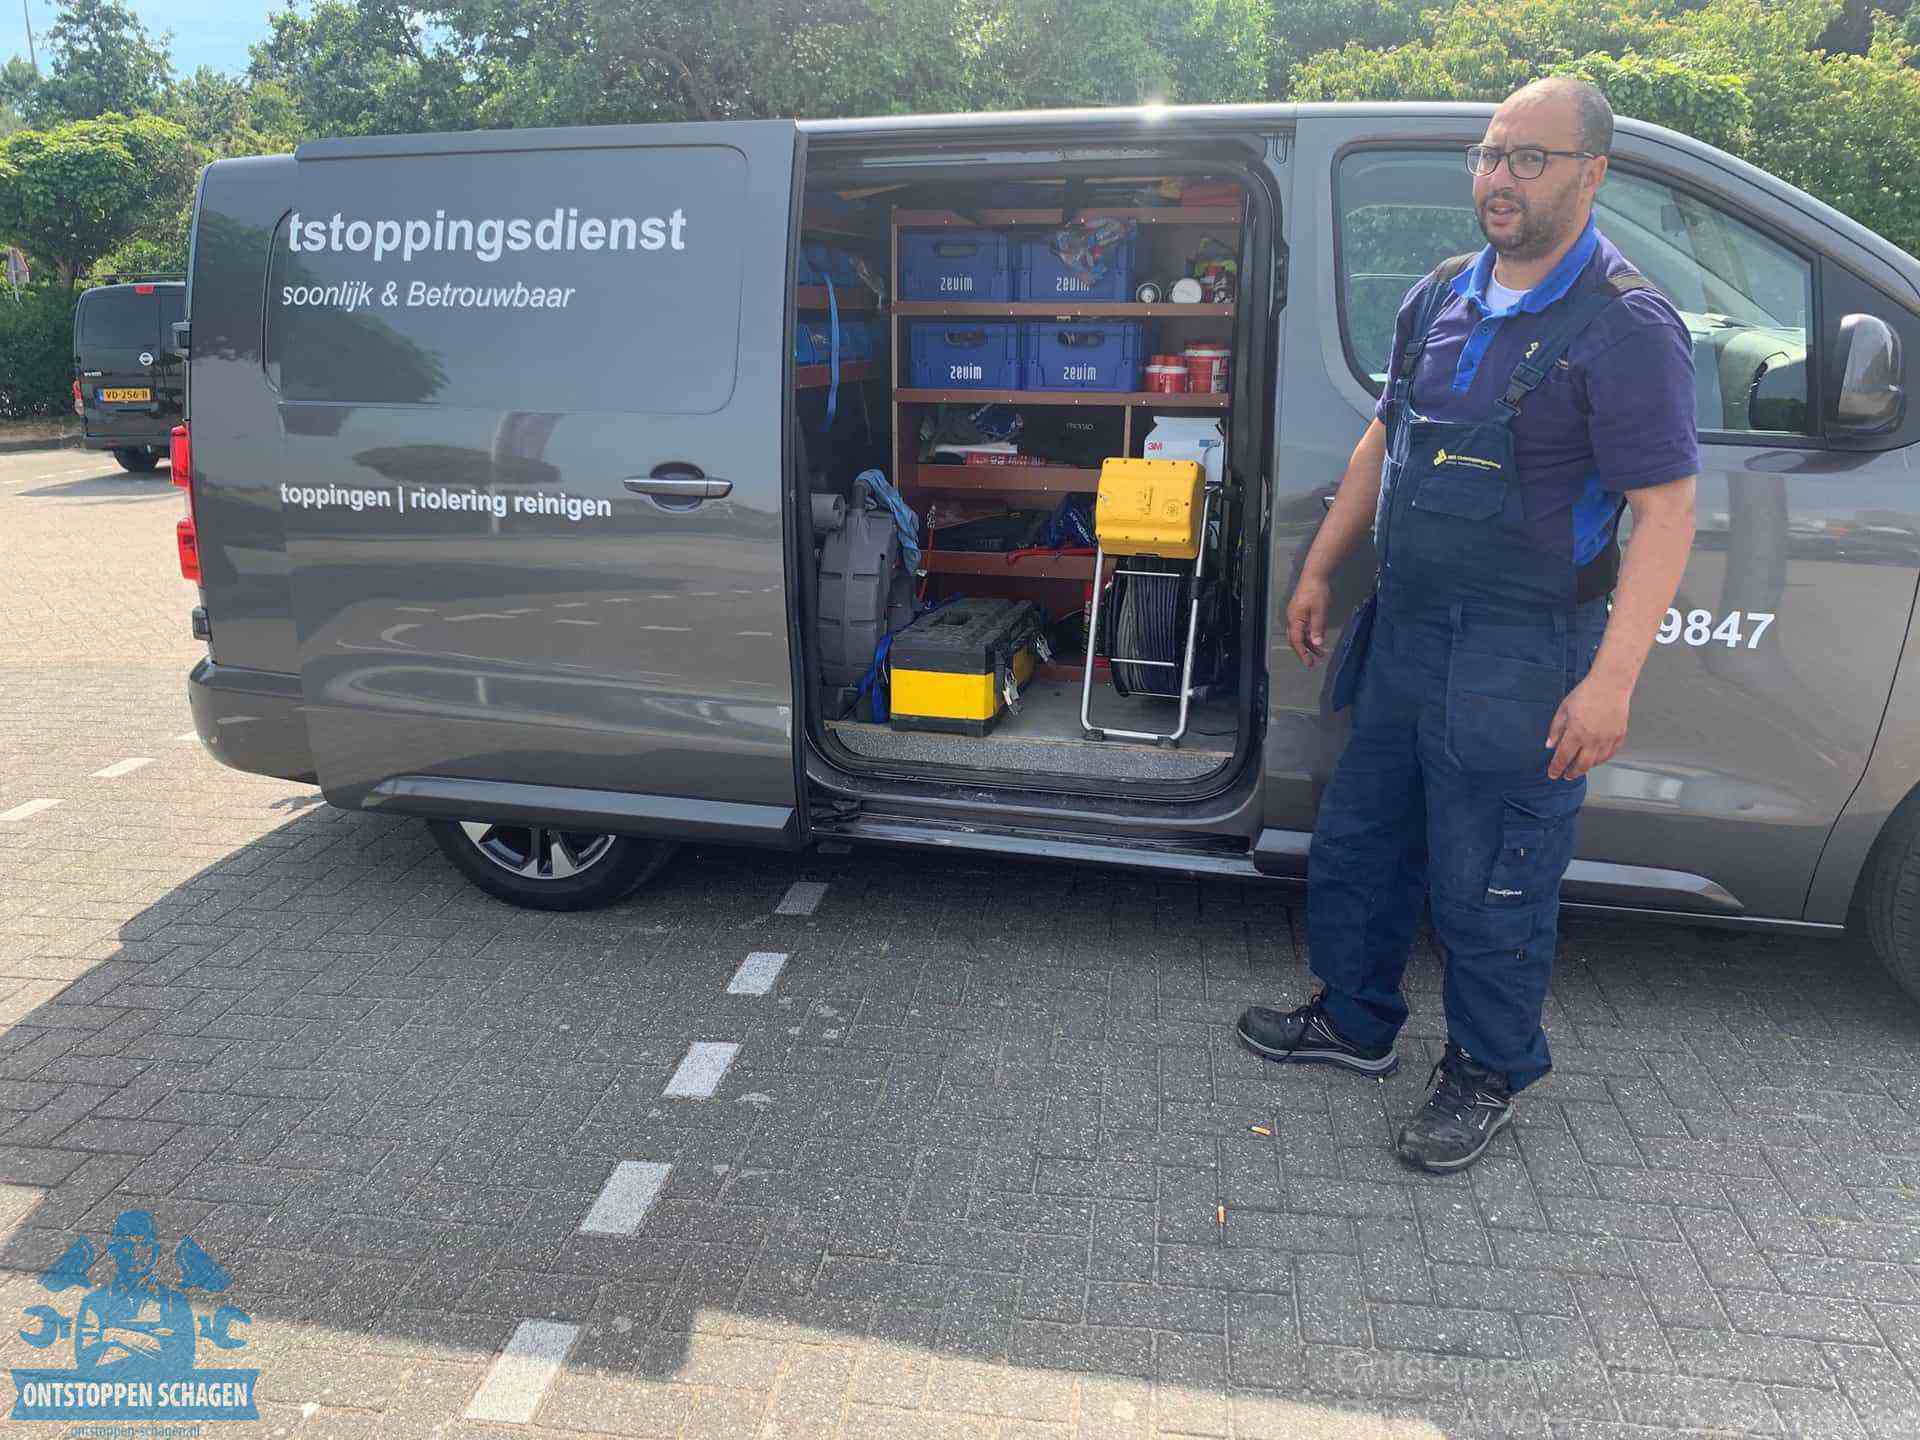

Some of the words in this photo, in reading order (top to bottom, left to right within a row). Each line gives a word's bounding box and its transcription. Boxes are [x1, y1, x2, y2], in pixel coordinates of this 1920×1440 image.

[289, 207, 687, 262] tstoppingsdienst
[282, 280, 374, 312] soonlijk
[381, 280, 398, 307] &
[407, 280, 576, 308] Betrouwbaar
[280, 483, 391, 511] toppingen
[410, 488, 507, 517] riolering
[514, 492, 611, 520] reinigen
[1655, 607, 1776, 649] 9847
